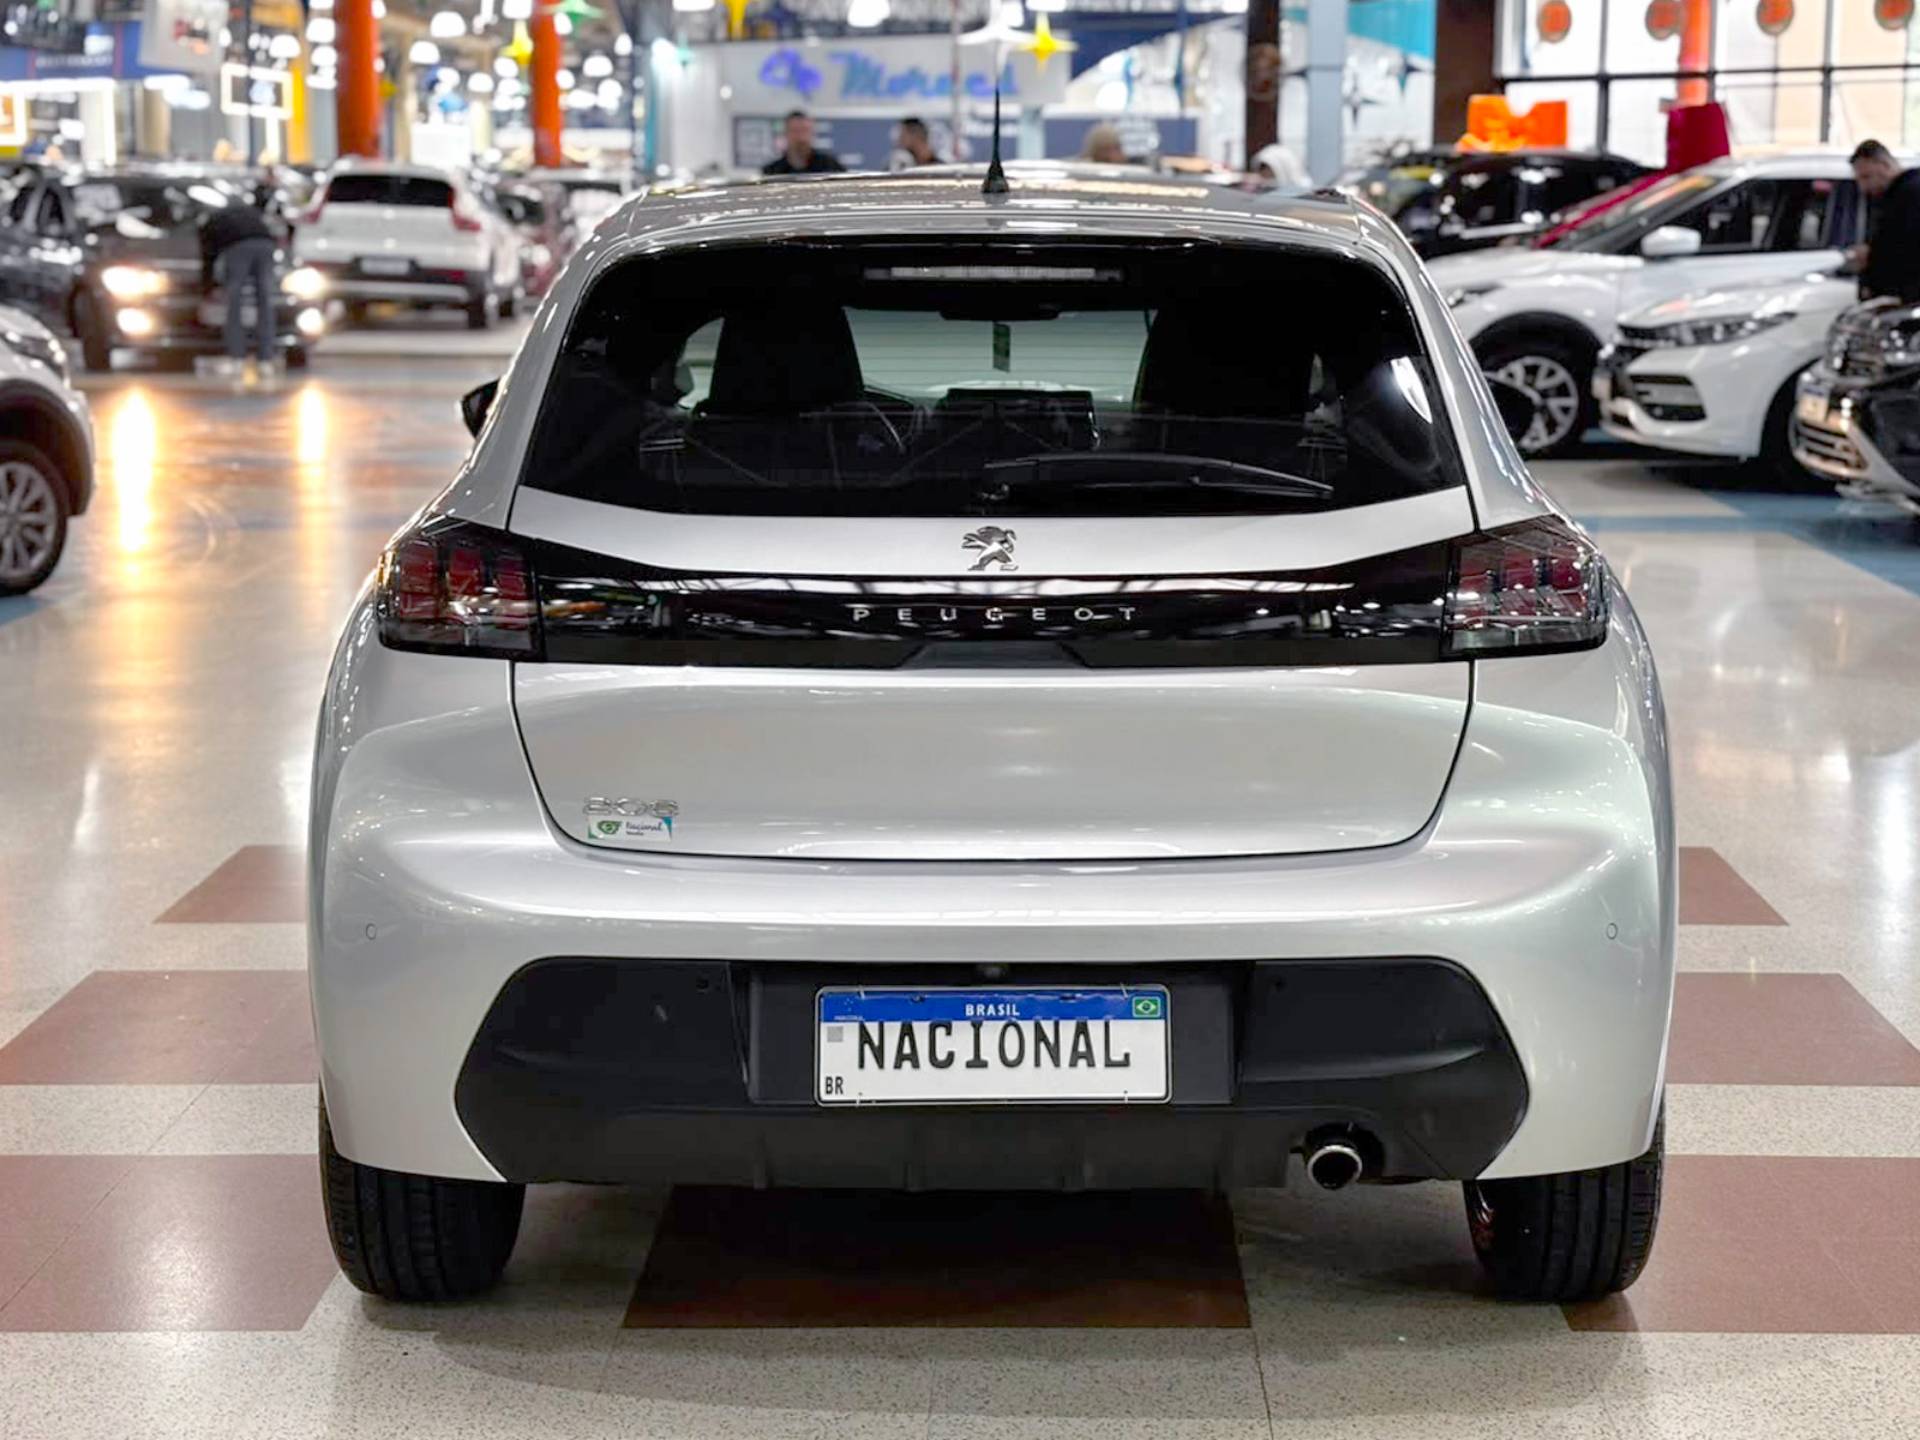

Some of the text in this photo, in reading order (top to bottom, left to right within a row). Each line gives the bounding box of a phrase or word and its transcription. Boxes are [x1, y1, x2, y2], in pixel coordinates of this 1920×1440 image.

[852, 607, 1137, 621] PEUGEOT
[964, 1004, 1020, 1018] BRASIL
[858, 1020, 1131, 1070] NACIONAL
[825, 1076, 845, 1096] BR
